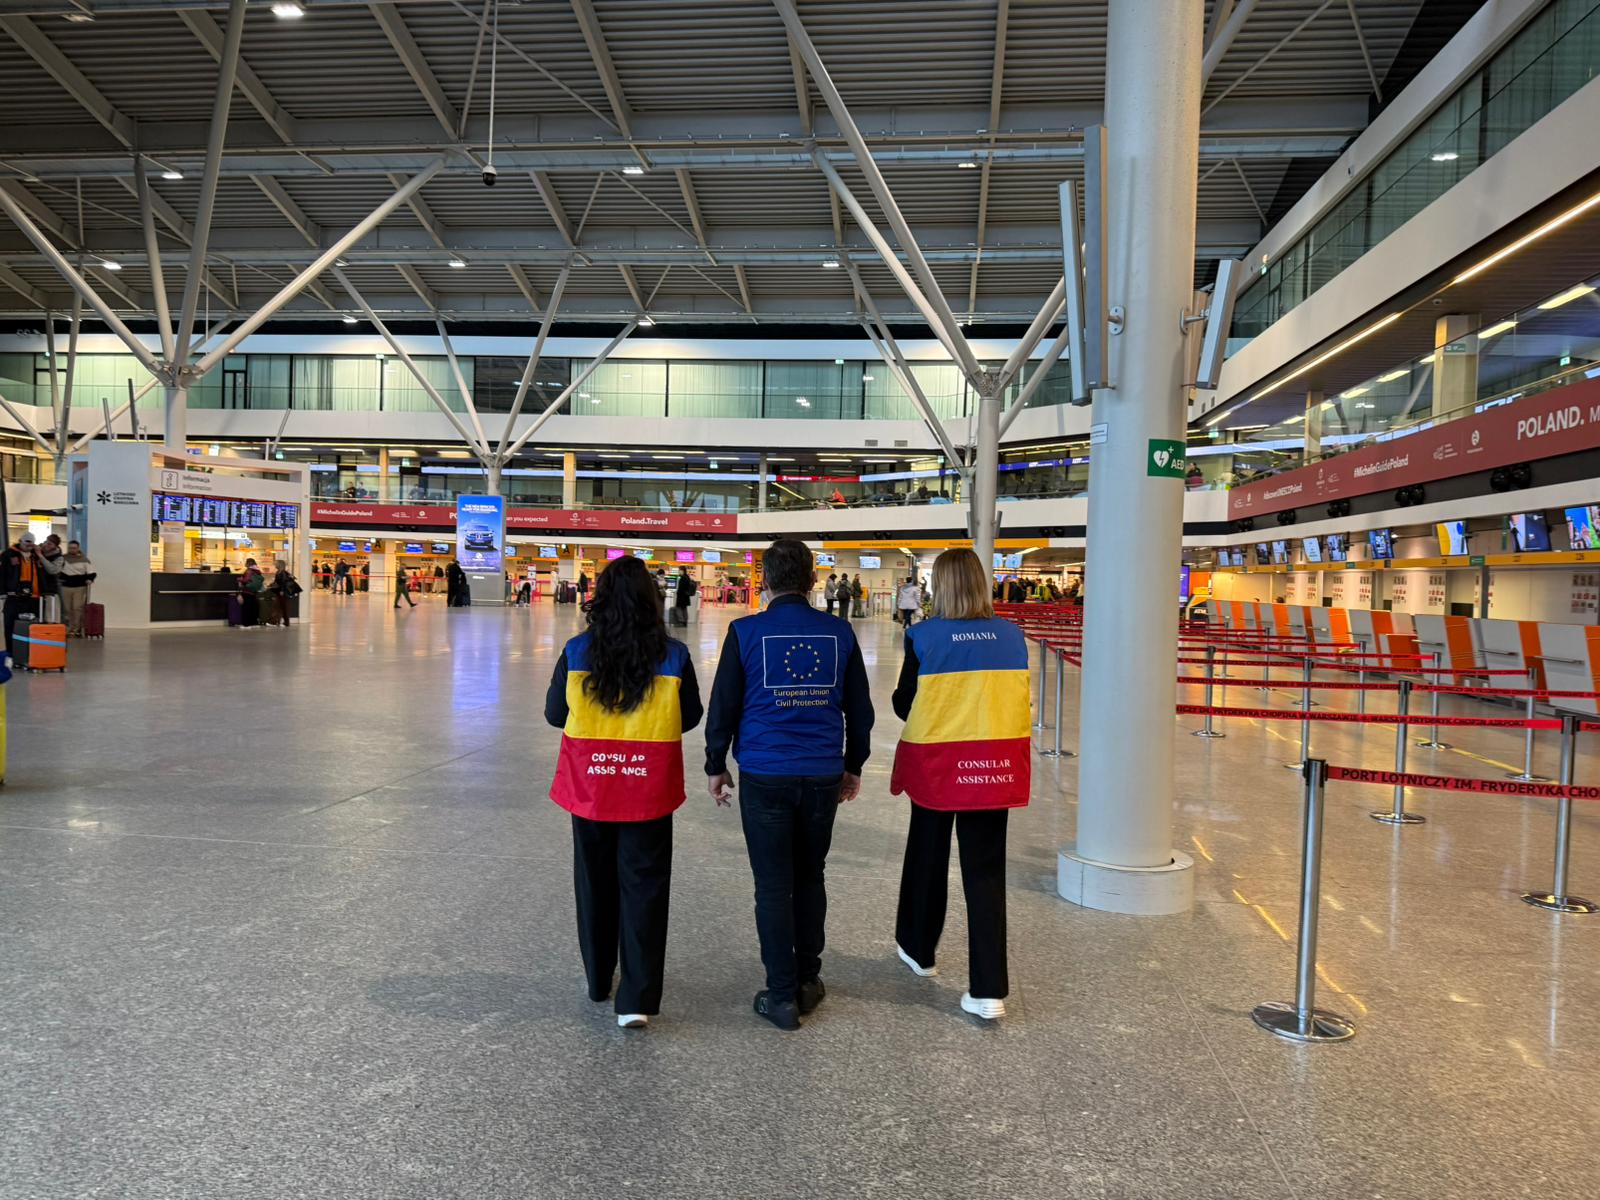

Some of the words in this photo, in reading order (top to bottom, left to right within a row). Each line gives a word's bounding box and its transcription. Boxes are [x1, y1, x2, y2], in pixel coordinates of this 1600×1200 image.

[1517, 406, 1585, 441] POLAND.
[1170, 458, 1185, 470] AED
[620, 516, 668, 526] Poland.Travel
[952, 632, 997, 642] ROMANIA
[773, 689, 808, 697] European
[809, 688, 830, 696] Union
[775, 699, 791, 707] Civil
[792, 699, 829, 707] Protection
[957, 759, 1011, 769] CONSULAR
[587, 765, 647, 776] ASSISANCE
[956, 774, 1015, 784] ASSISTANCE
[1342, 769, 1377, 782] PORT
[1382, 773, 1449, 788] LOTNICZY
[1453, 780, 1476, 790] IM.
[1480, 782, 1564, 797] FRYDERYKA
[1569, 786, 1600, 798] CHO
